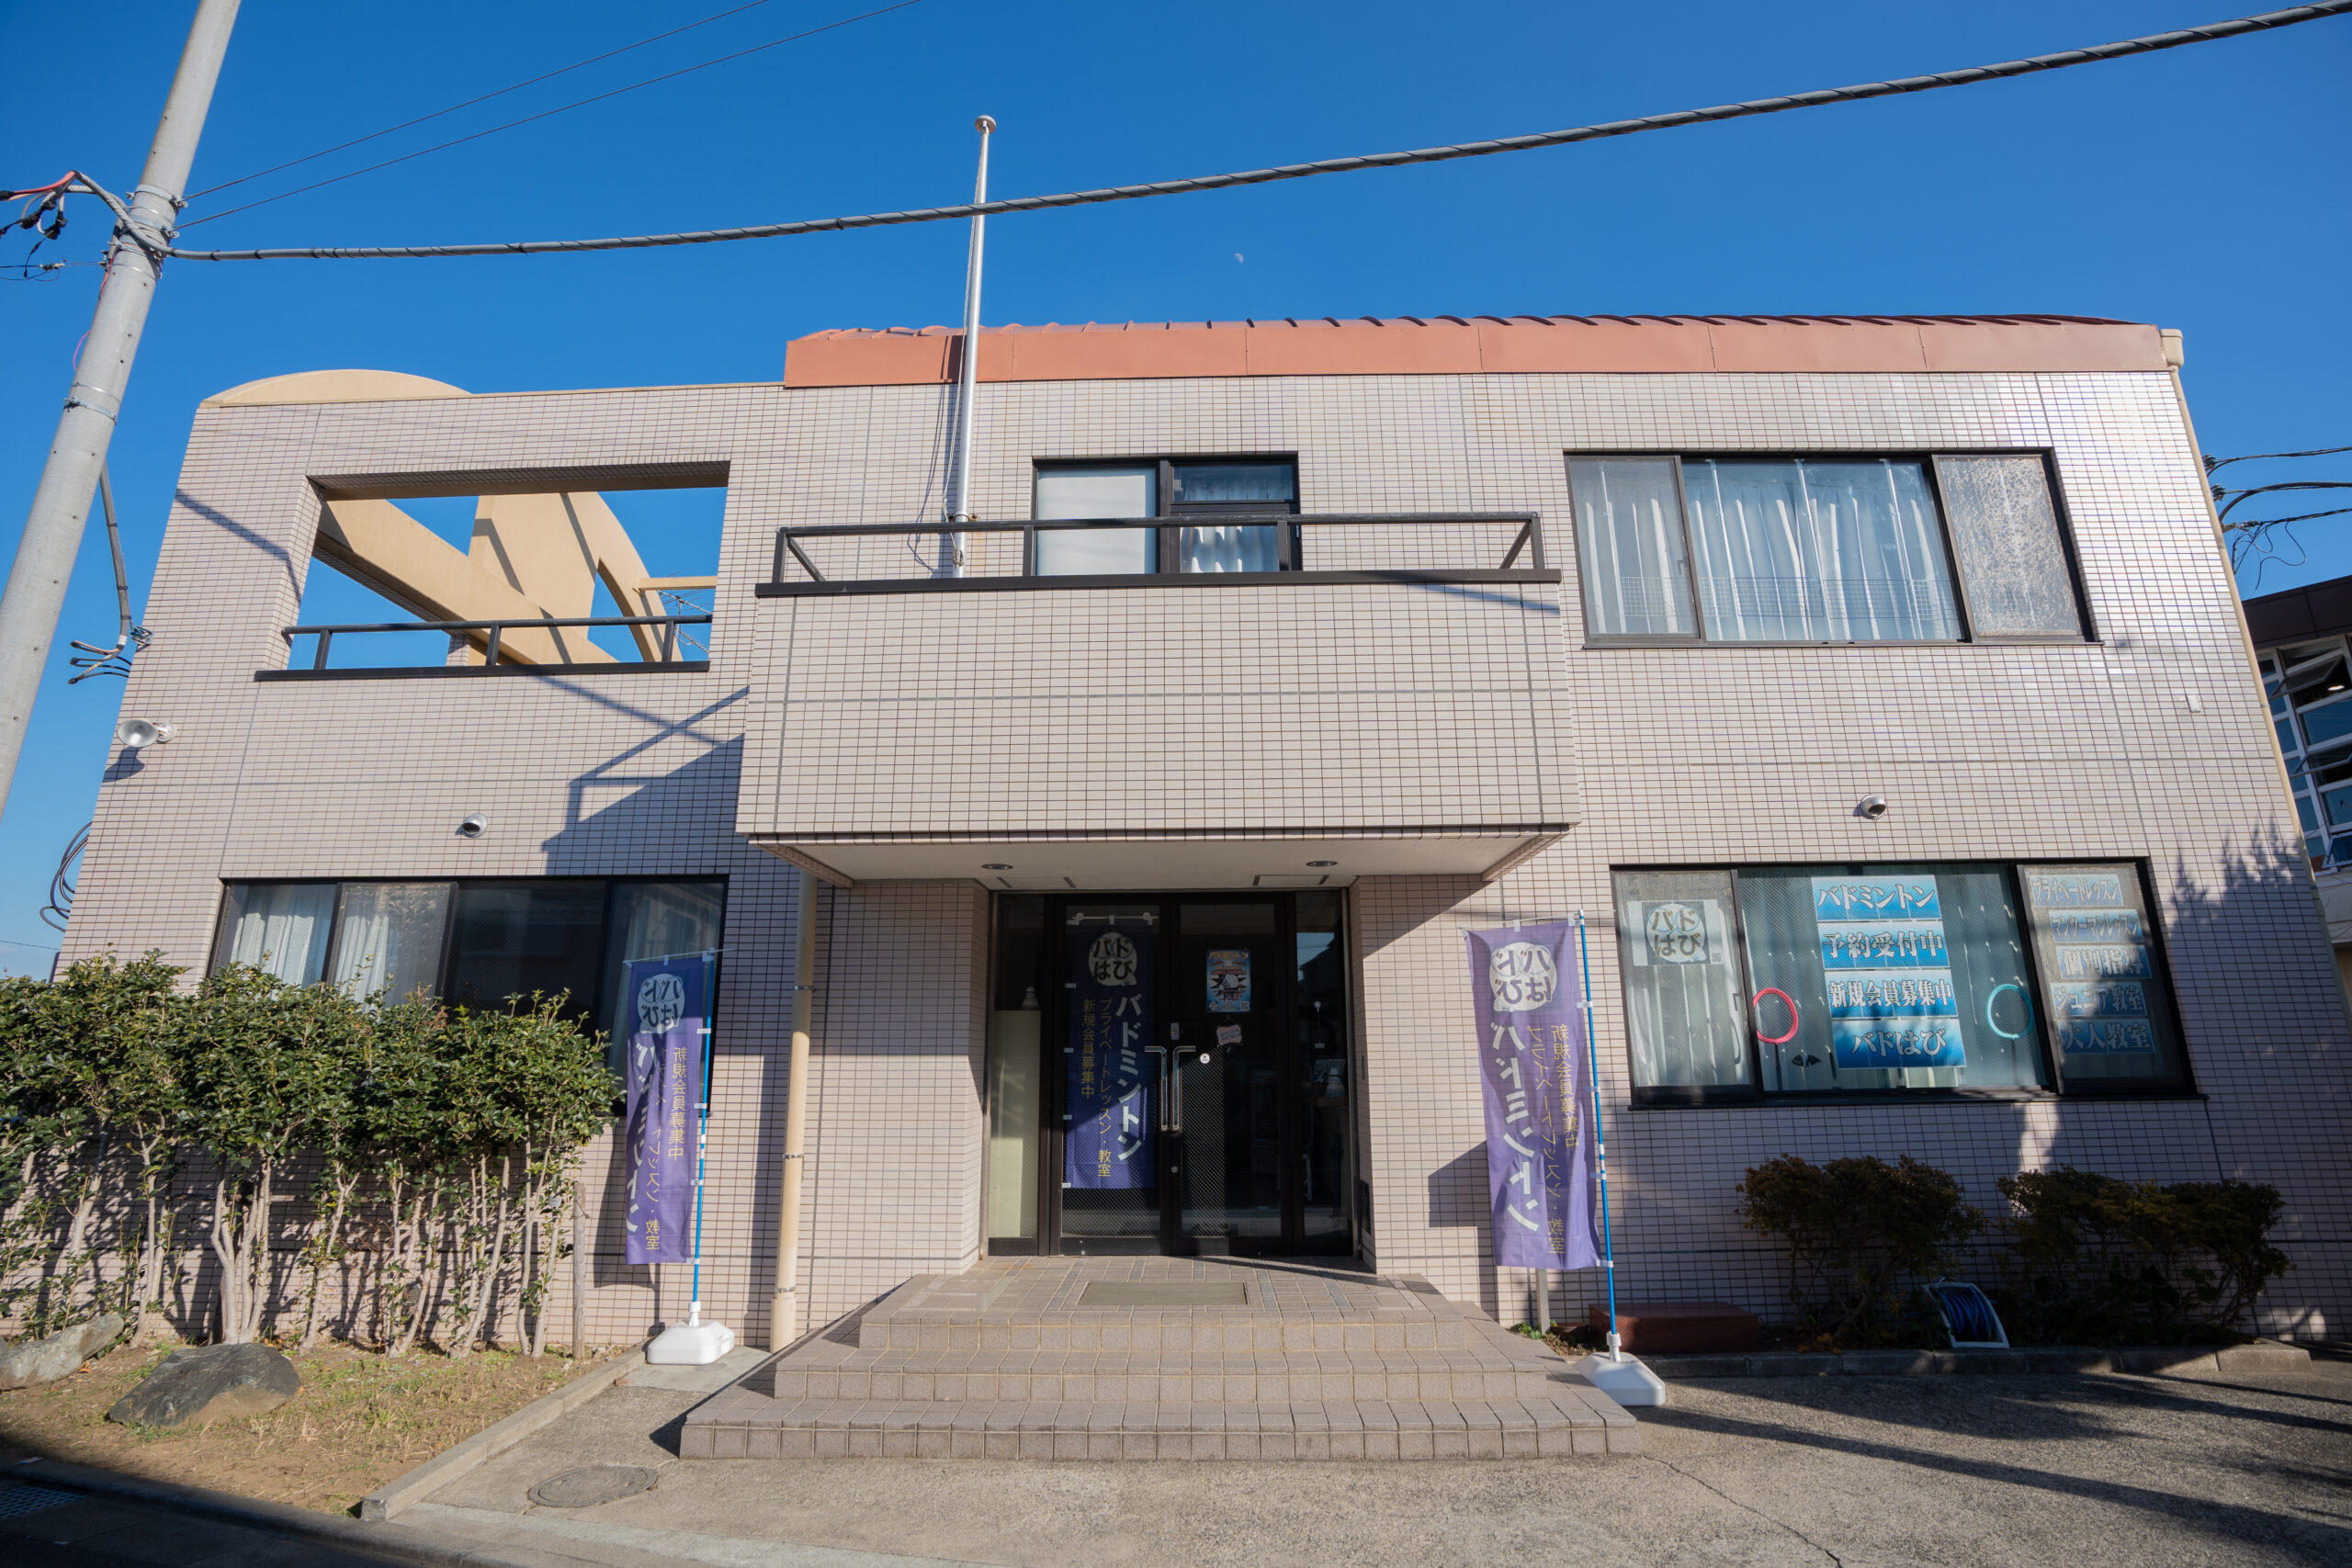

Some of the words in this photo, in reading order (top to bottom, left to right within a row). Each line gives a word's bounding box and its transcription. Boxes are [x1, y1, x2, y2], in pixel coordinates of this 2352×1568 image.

[1816, 884, 1935, 910] バドミントン
[1651, 909, 1697, 932] バド
[1092, 937, 1133, 958] バド
[1654, 933, 1702, 957] はび
[1823, 931, 1944, 959] 予約受付中
[1093, 960, 1134, 981] はび
[2062, 948, 2143, 976] 個別指導
[1828, 979, 1952, 1008] 新規会員募集中
[2053, 984, 2143, 1012] ジュニア教室
[1080, 998, 1096, 1100] 新規会員募集中
[1851, 1028, 1948, 1057] バドはび
[2061, 1021, 2151, 1050] 大人教室
[1114, 992, 1143, 1161] バドミントン
